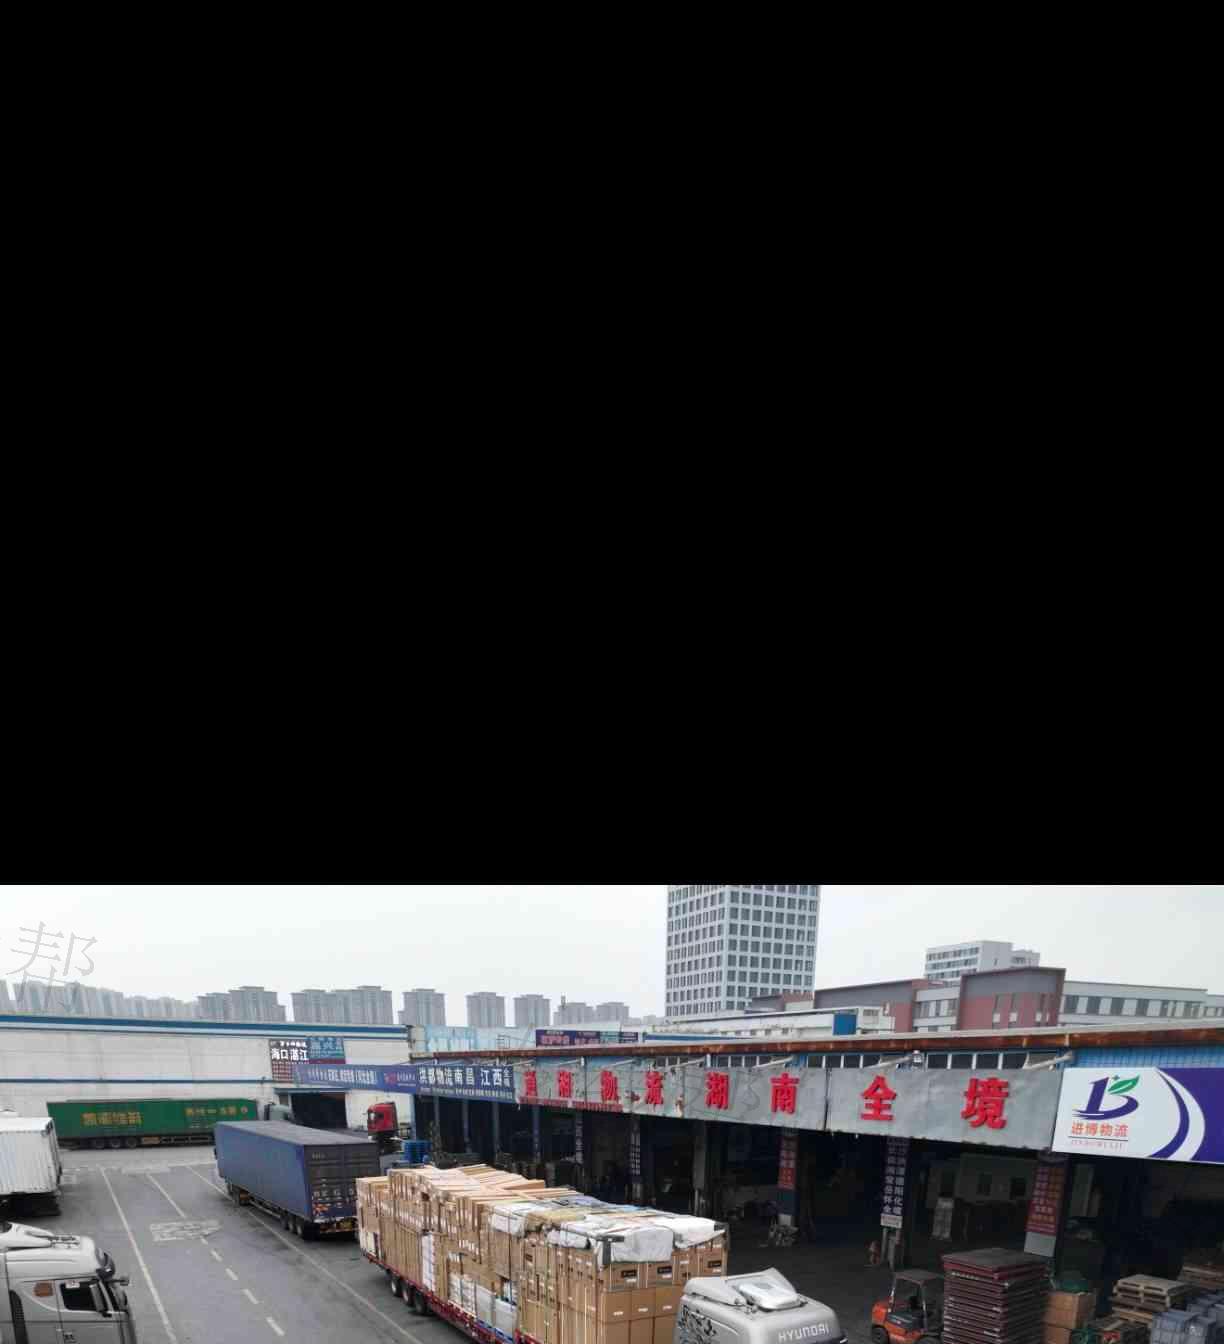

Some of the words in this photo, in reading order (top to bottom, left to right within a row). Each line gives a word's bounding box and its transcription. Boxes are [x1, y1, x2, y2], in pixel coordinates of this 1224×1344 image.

[1071, 1121, 1129, 1137] 进博物流
[778, 1322, 830, 1342] HYUNDAI
